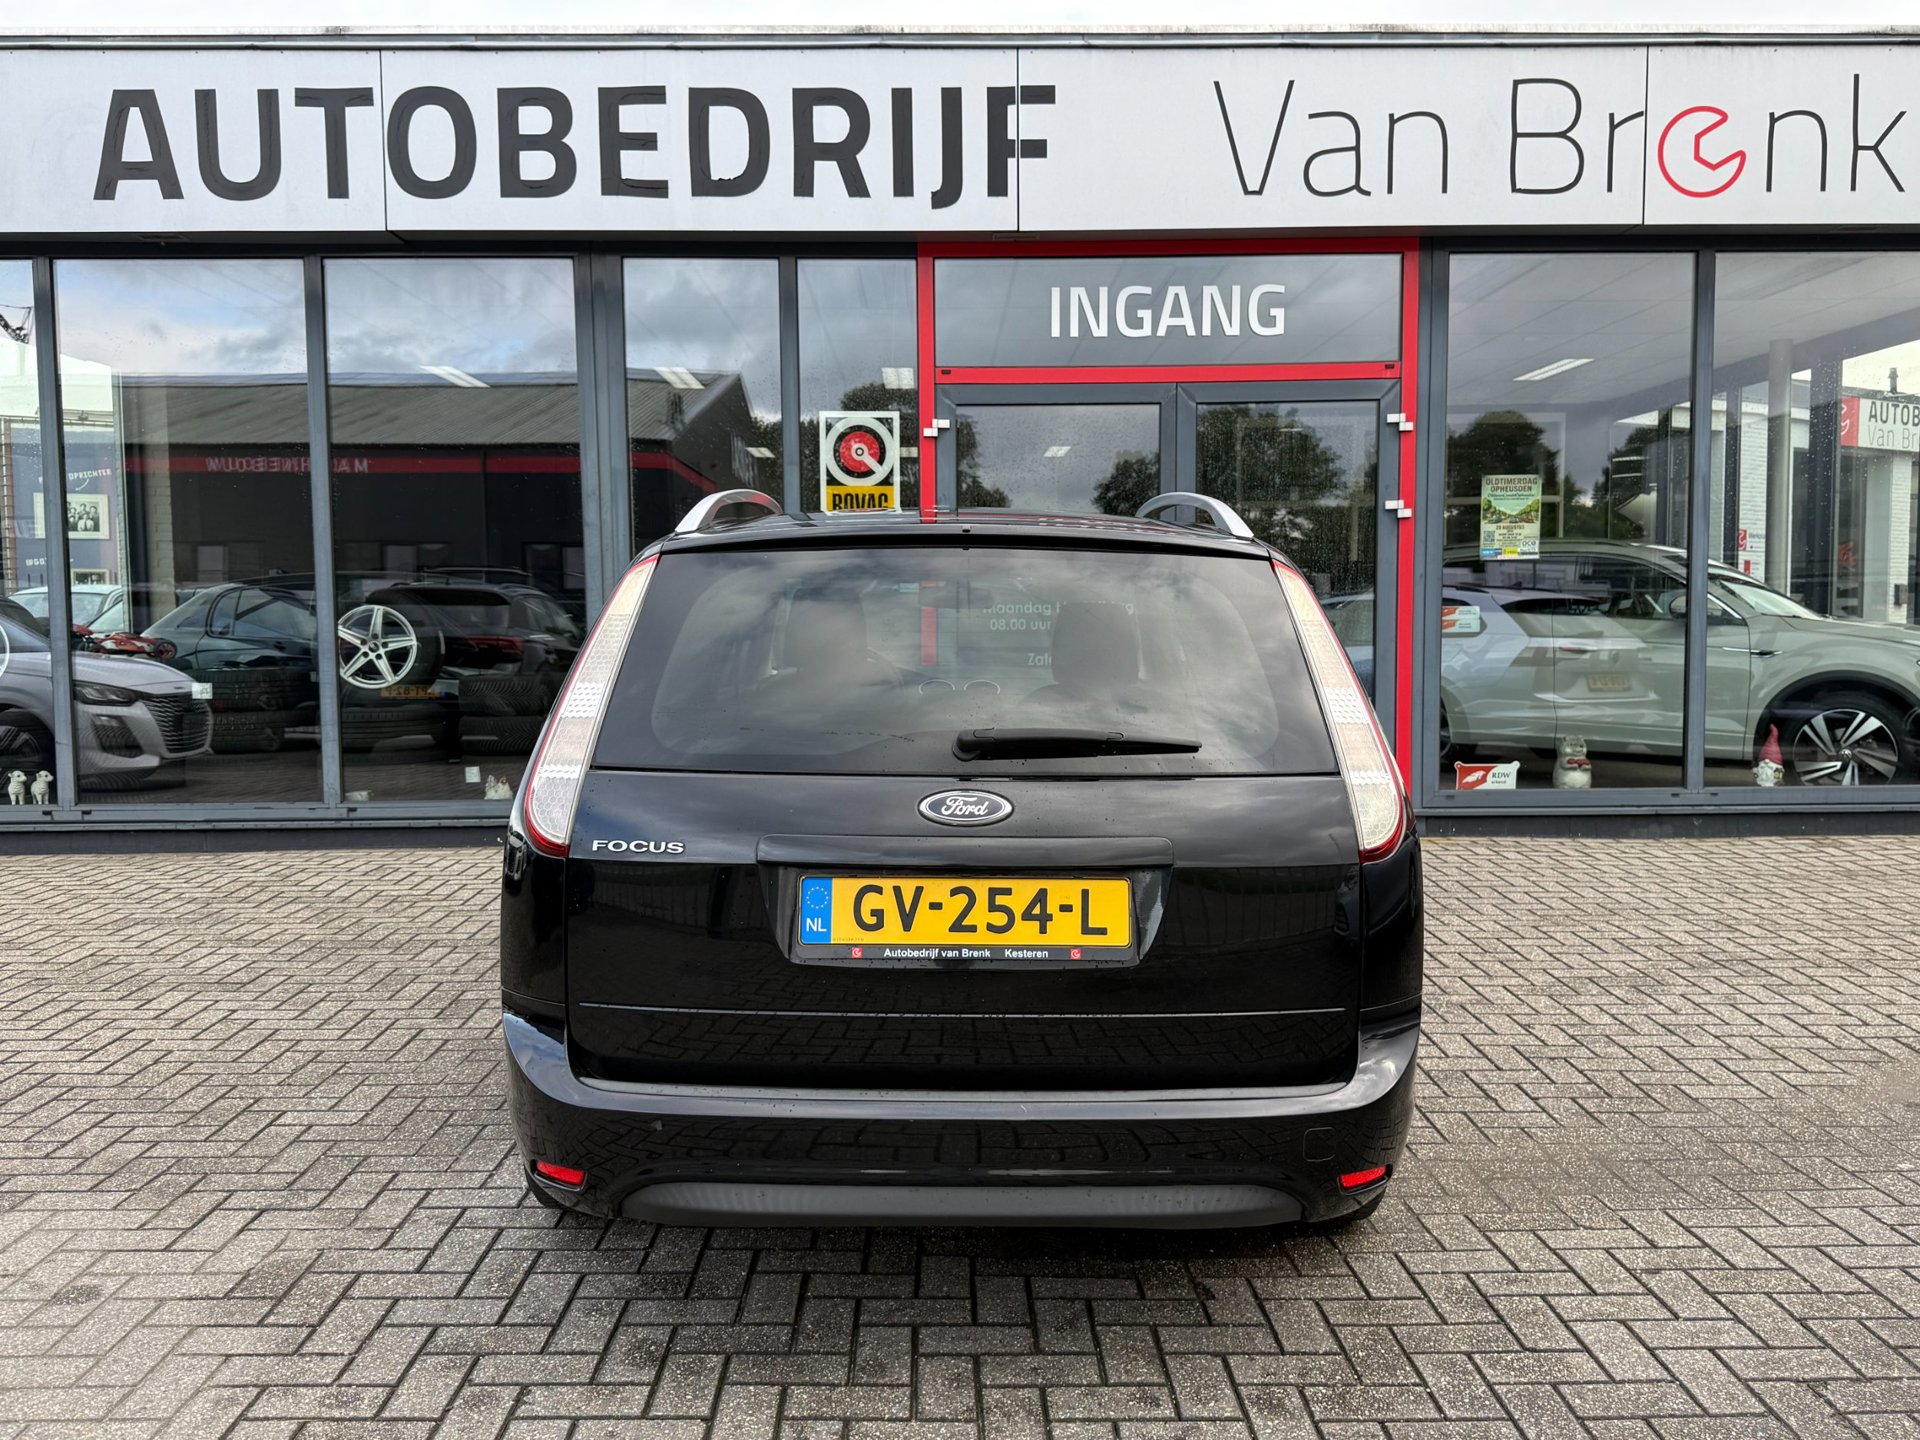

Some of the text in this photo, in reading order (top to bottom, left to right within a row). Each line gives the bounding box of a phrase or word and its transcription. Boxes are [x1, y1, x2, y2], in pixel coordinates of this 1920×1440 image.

[1213, 73, 1908, 199] Van Brenk
[93, 85, 1057, 209] AUTOBEDRIJF
[1051, 284, 1286, 338] INGANG
[1867, 424, 1895, 447] Van
[1485, 477, 1538, 486] OLDTIMERDAG
[1490, 485, 1532, 493] OPHEUSDEN
[1491, 771, 1512, 779] RDW
[941, 796, 989, 816] Ford
[592, 839, 684, 854] FOCUS
[853, 884, 1108, 936] GV-254-L
[806, 917, 827, 932] NL
[884, 948, 939, 959] Autobedrijf
[962, 948, 991, 958] Brenk
[1005, 949, 1049, 958] Kesteren
